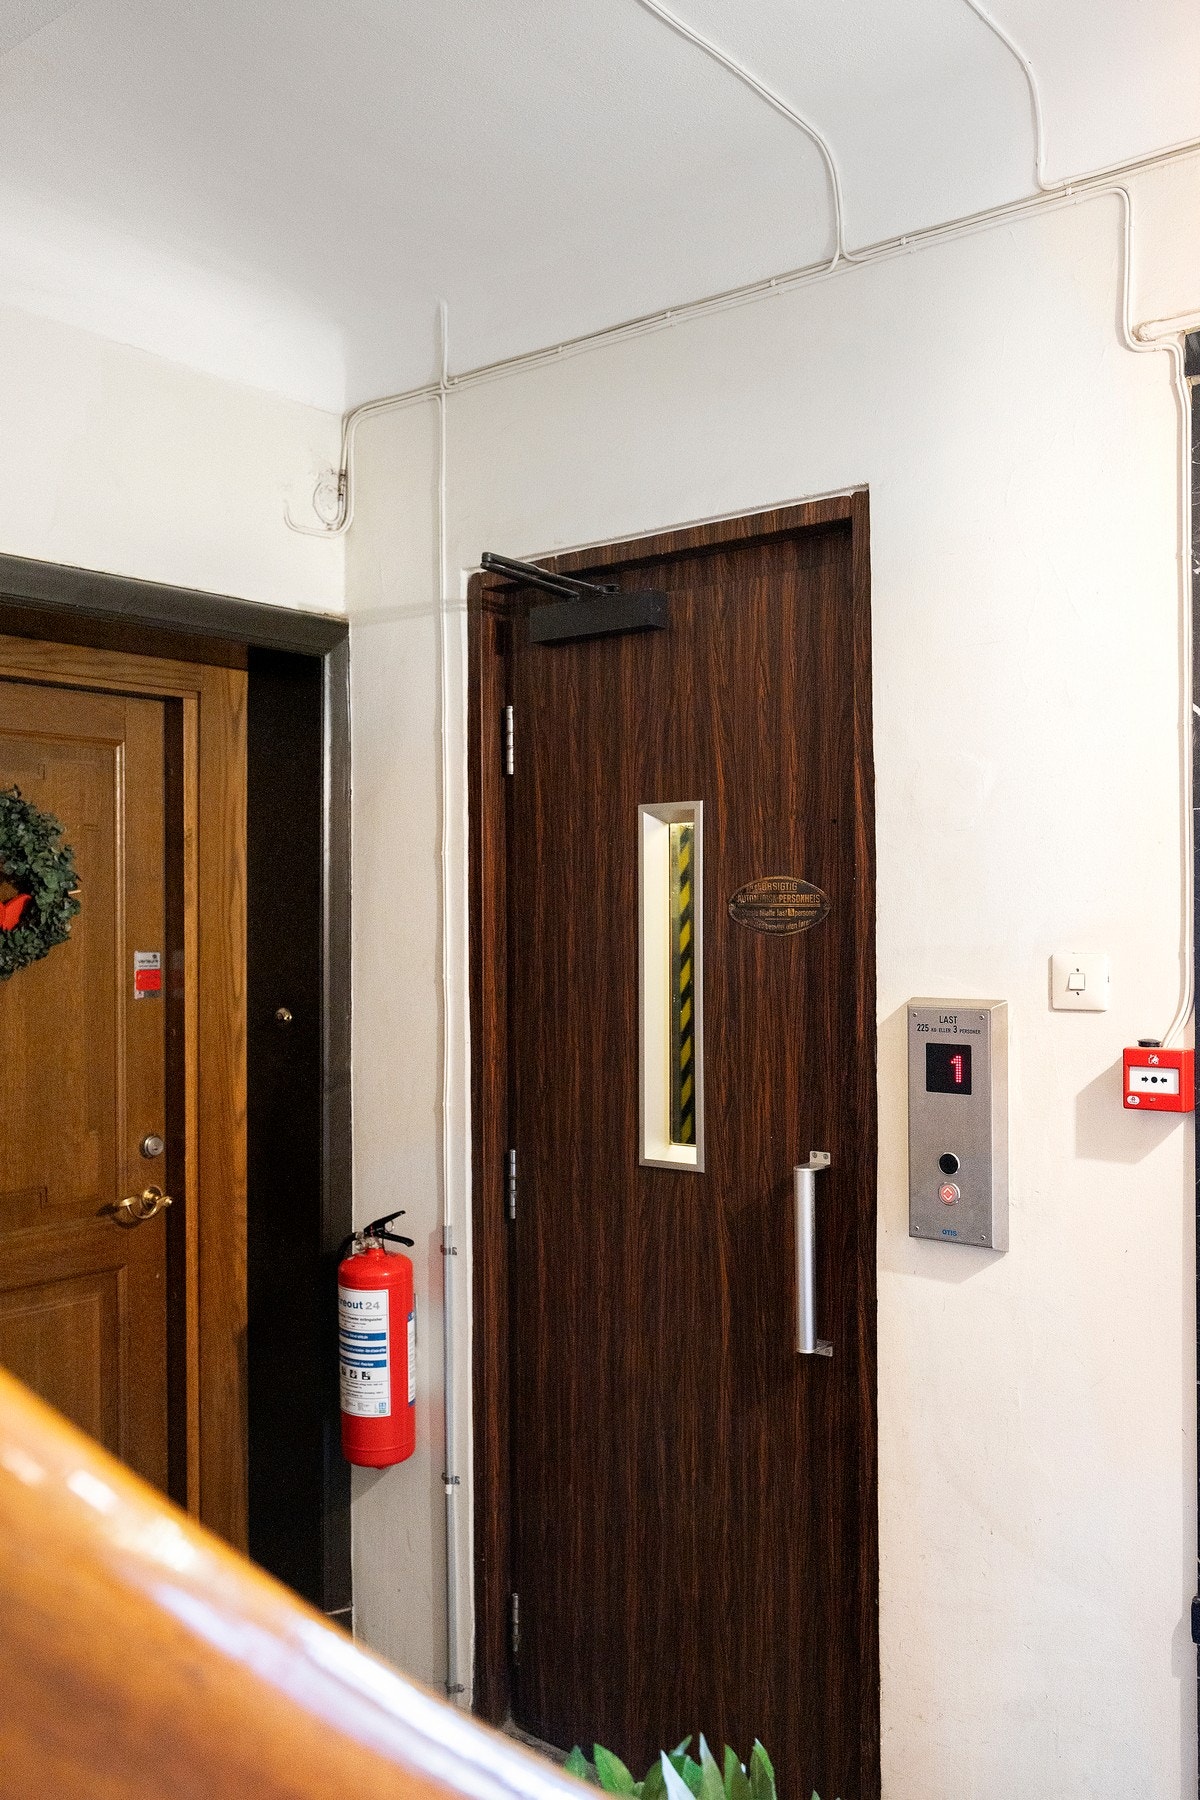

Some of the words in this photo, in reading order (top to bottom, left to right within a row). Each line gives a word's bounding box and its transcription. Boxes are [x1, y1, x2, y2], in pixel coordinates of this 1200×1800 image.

[939, 1015, 957, 1024] LAST
[916, 1024, 929, 1032] 225
[953, 1025, 958, 1034] 3
[950, 1055, 962, 1083] 1
[942, 1229, 958, 1237] OTIS
[339, 1299, 364, 1310] reout
[365, 1301, 380, 1310] 24
